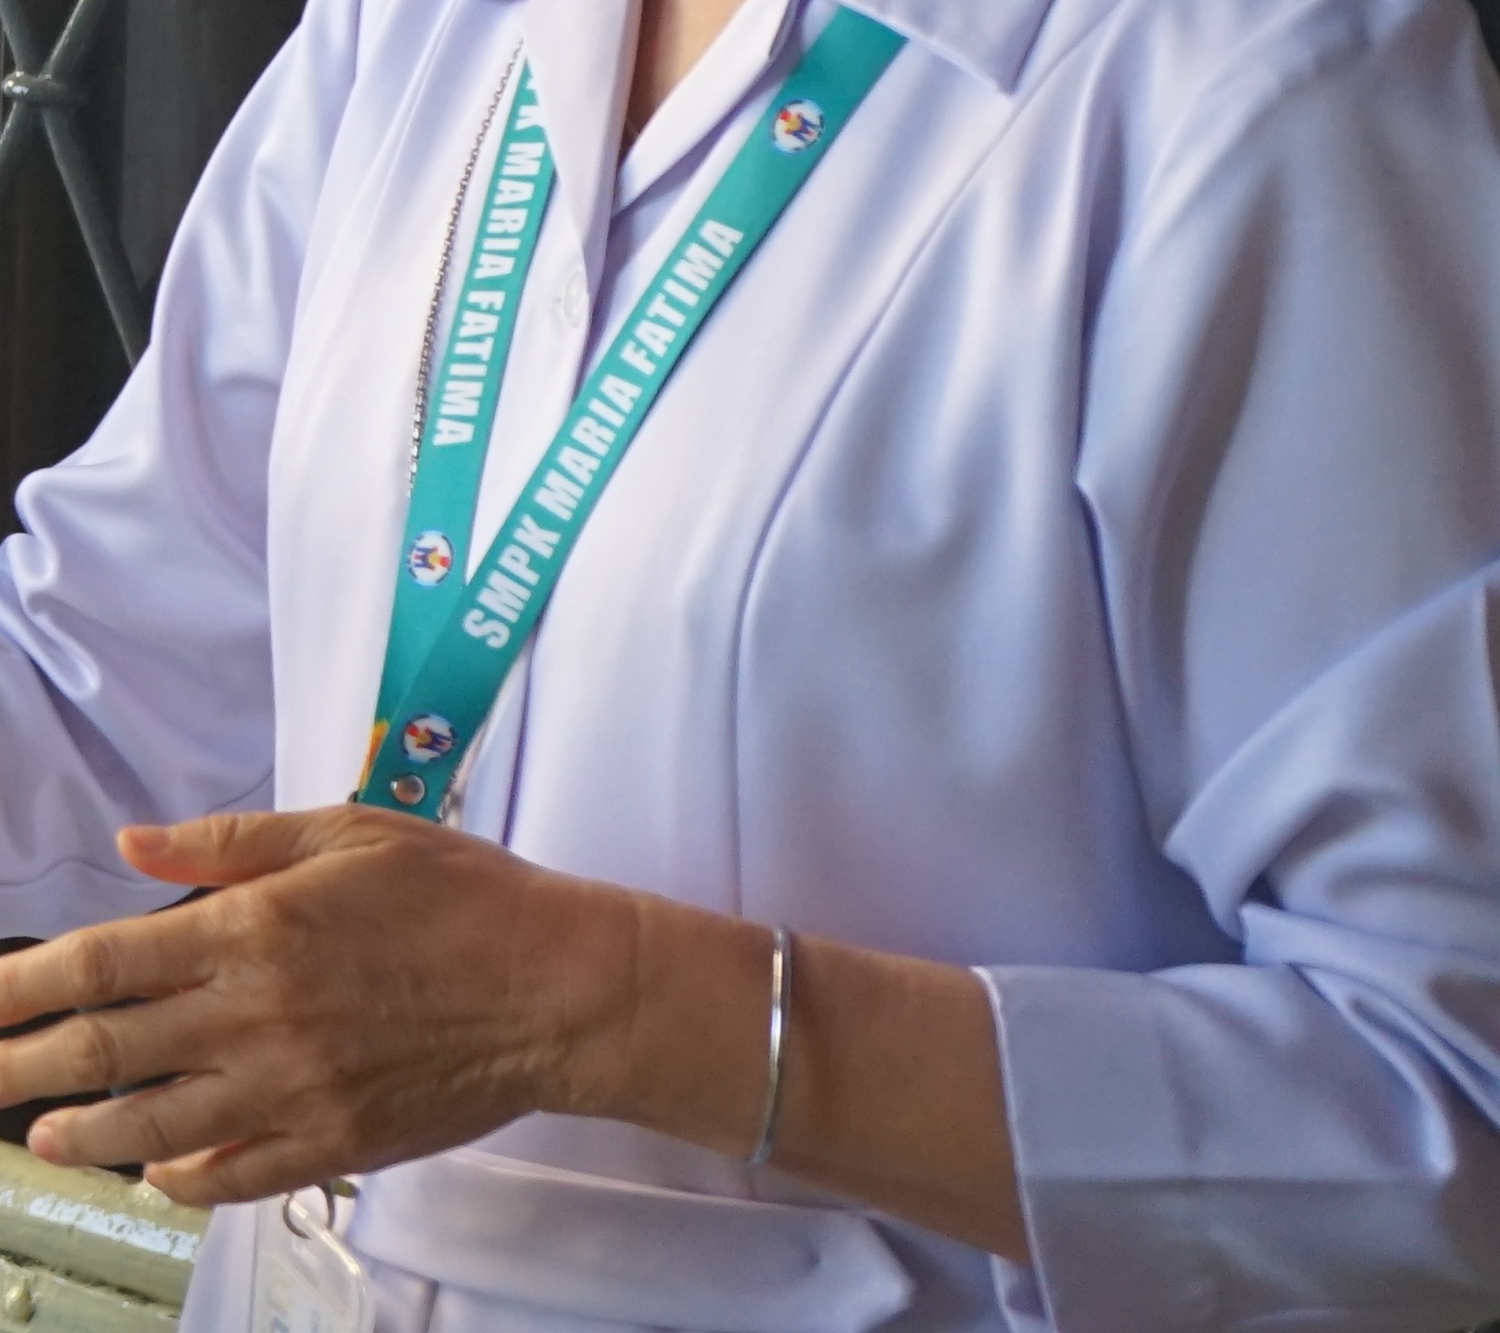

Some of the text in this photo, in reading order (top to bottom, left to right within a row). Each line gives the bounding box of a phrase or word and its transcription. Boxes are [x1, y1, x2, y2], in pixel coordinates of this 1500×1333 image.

[474, 141, 545, 279] MARIA
[433, 290, 506, 446] FATIMA
[462, 219, 743, 649] SMPK MARIA FATIMA
